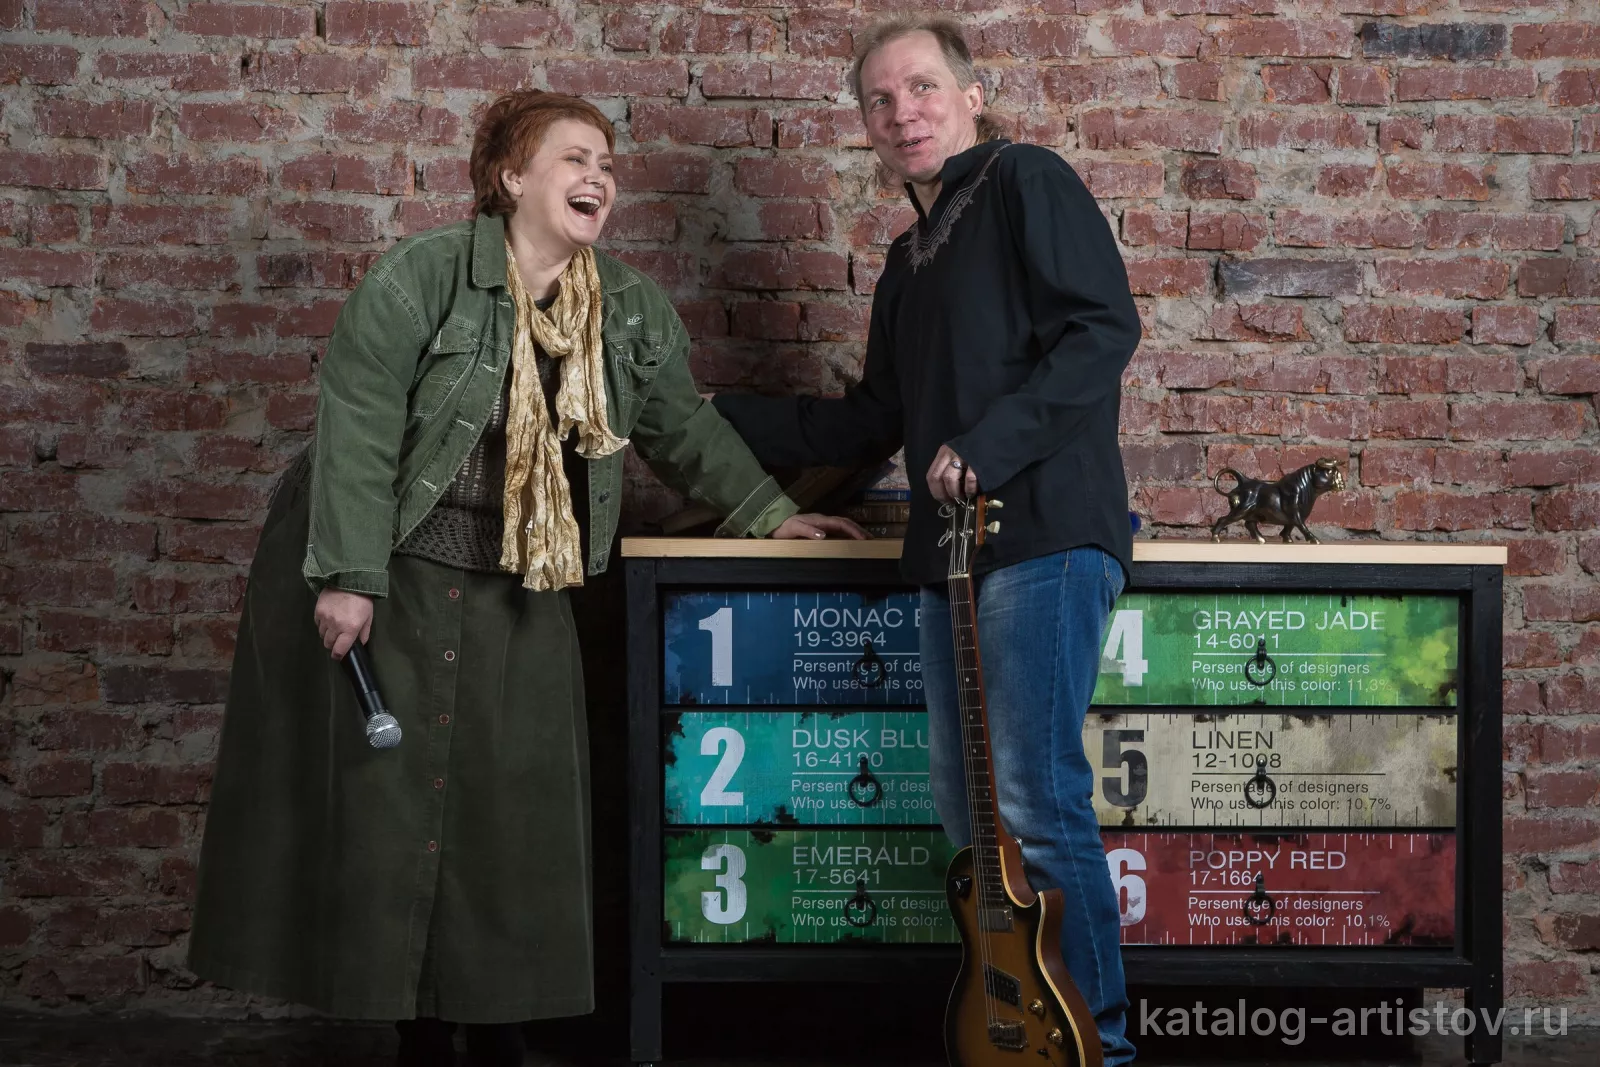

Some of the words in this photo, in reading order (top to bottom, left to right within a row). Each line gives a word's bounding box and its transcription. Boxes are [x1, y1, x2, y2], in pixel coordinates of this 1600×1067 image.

[794, 608, 903, 628] MONAC
[1193, 610, 1305, 631] GRAYED
[1315, 610, 1385, 631] JADE
[698, 607, 733, 687] 1
[794, 631, 887, 648] 19-3964
[1101, 609, 1148, 687] 4
[884, 659, 899, 673] of
[1192, 661, 1274, 676] Persenage
[1280, 660, 1296, 674] of
[1299, 660, 1370, 676] designers
[793, 676, 827, 690] Who
[1192, 677, 1225, 691] Who
[1230, 677, 1264, 691] used
[1270, 677, 1296, 691] this
[1301, 677, 1341, 691] color:
[792, 729, 870, 749] DUSK
[1192, 730, 1273, 749] LINEN
[700, 726, 746, 807] 2
[1101, 729, 1148, 808] 5
[881, 779, 896, 793] of
[1191, 780, 1273, 795] Persentage
[1280, 780, 1294, 793] of
[1298, 780, 1369, 796] designers
[791, 796, 825, 809] Who
[1191, 797, 1224, 811] Who
[1228, 797, 1262, 811] used
[1269, 797, 1295, 811] this
[1300, 797, 1340, 811] color:
[793, 846, 930, 866] EMERALD
[1189, 850, 1281, 870] POPPY
[1290, 850, 1347, 870] RED
[701, 843, 748, 925] 3
[793, 869, 881, 885] 17-5641
[1105, 848, 1147, 928] 6
[881, 896, 896, 910] of
[1188, 897, 1271, 912] Persentage
[1275, 897, 1290, 911] of
[1293, 897, 1364, 912] designers
[792, 913, 825, 927] Who
[902, 913, 943, 927] color:
[1188, 913, 1222, 927] Who
[1226, 913, 1260, 927] used
[1295, 913, 1335, 927] color:
